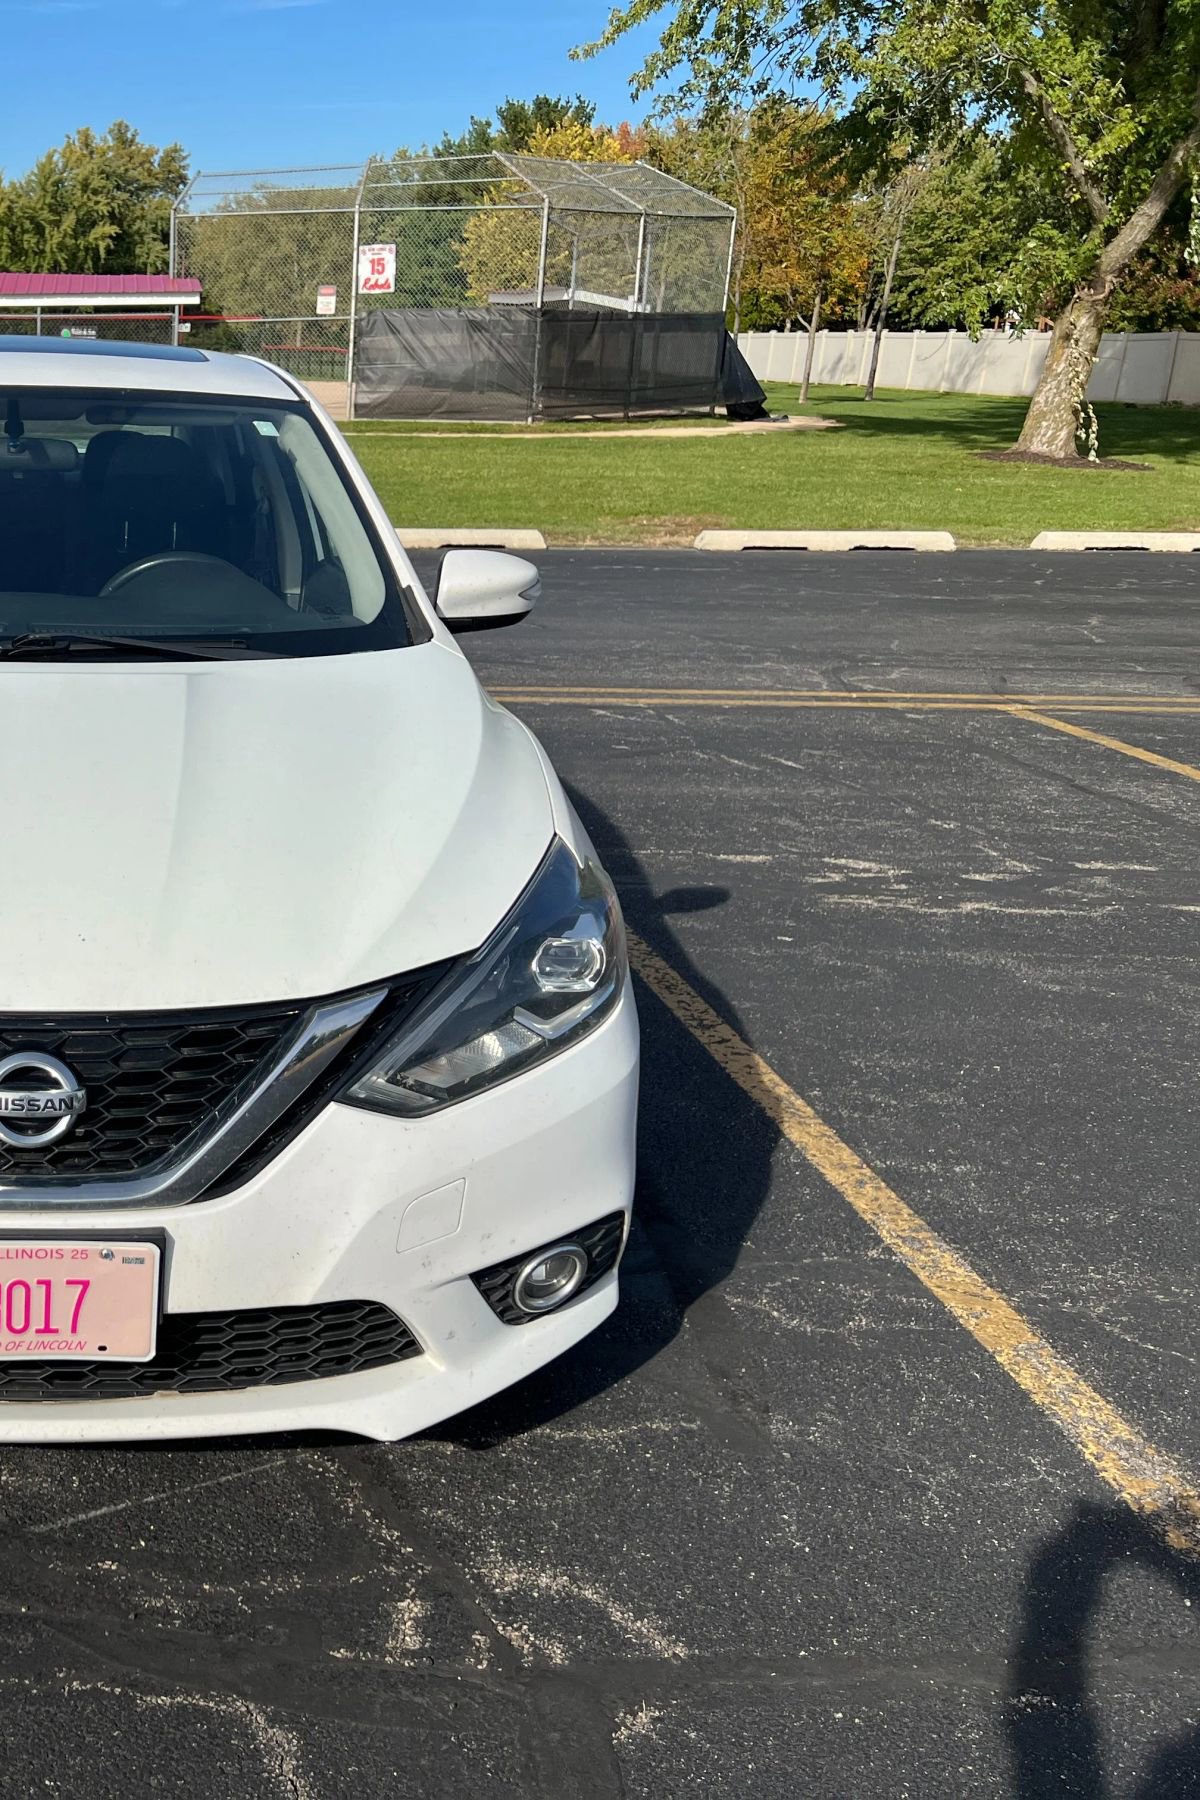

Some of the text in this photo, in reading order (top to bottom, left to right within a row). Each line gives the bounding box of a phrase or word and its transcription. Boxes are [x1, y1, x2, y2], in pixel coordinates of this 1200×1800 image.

[369, 257, 385, 275] 15
[71, 1248, 89, 1260] 25
[5, 1340, 26, 1352] OF
[26, 1340, 88, 1352] LINCOLN
